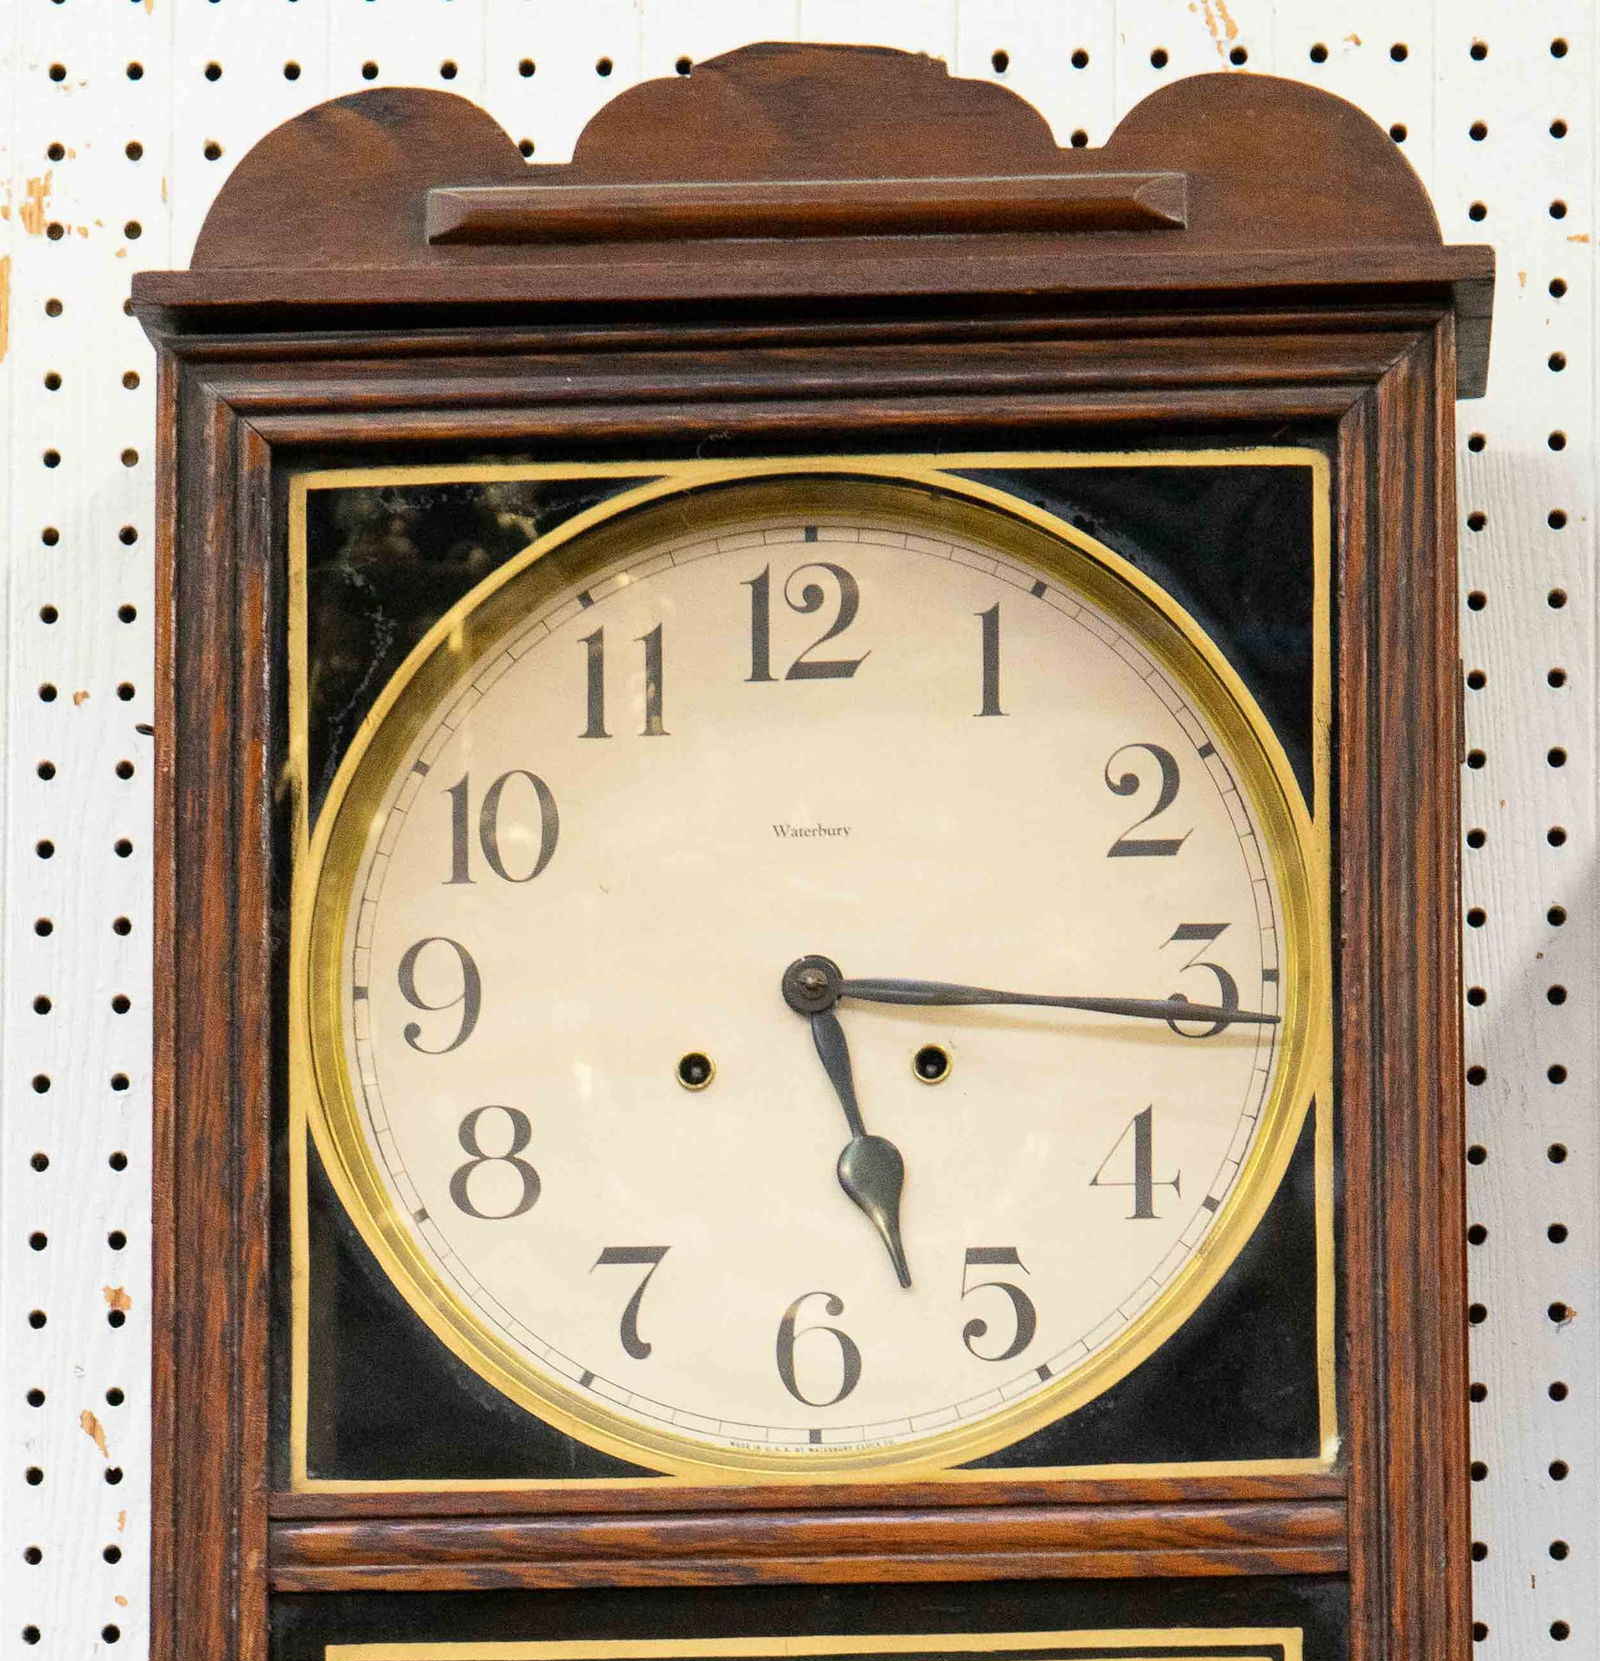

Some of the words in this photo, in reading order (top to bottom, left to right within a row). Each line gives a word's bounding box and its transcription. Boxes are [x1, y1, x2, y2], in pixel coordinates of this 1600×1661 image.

[740, 562, 872, 682] 12
[973, 601, 1010, 718] 1
[576, 622, 671, 739] 11
[442, 769, 560, 885] 10
[771, 823, 852, 838] Waterbury
[1104, 743, 1192, 858] 2
[397, 937, 482, 1054] 9
[1159, 922, 1239, 1038] 3
[449, 1105, 541, 1220] 8
[1088, 1104, 1181, 1220] 4
[589, 1246, 671, 1360] 7
[775, 1292, 862, 1408] 6
[960, 1247, 1037, 1362] 5
